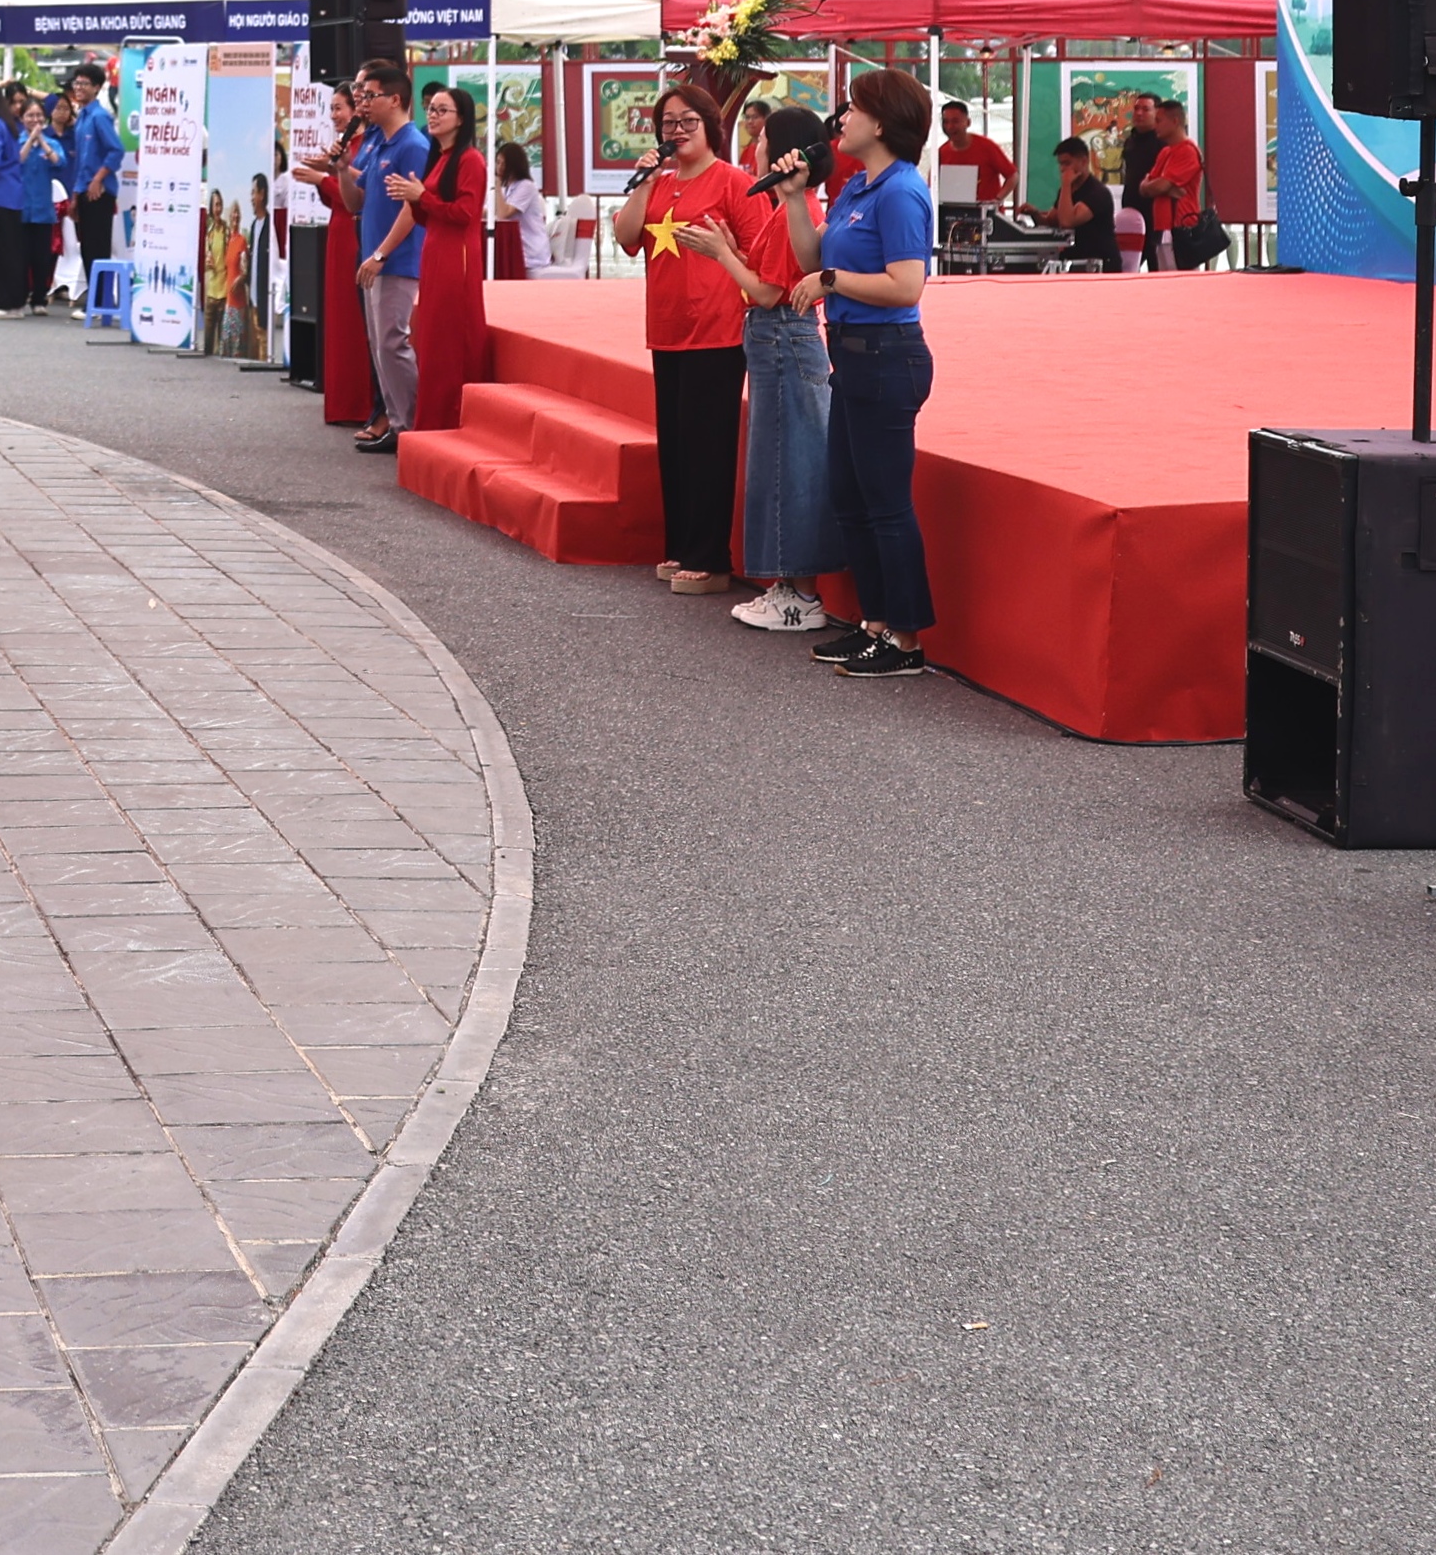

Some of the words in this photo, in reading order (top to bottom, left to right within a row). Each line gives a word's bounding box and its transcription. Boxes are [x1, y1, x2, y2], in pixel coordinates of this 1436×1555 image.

[34, 16, 61, 35] BỆNH
[62, 16, 84, 33] VIỆN
[85, 17, 100, 31] ĐA
[101, 16, 128, 31] KHOA
[129, 12, 152, 30] ĐỨC
[153, 15, 187, 30] GIANG
[228, 13, 245, 30] HỘI
[277, 10, 300, 27] GIÁO
[437, 8, 458, 25] VIỆT
[460, 9, 483, 23] NAM
